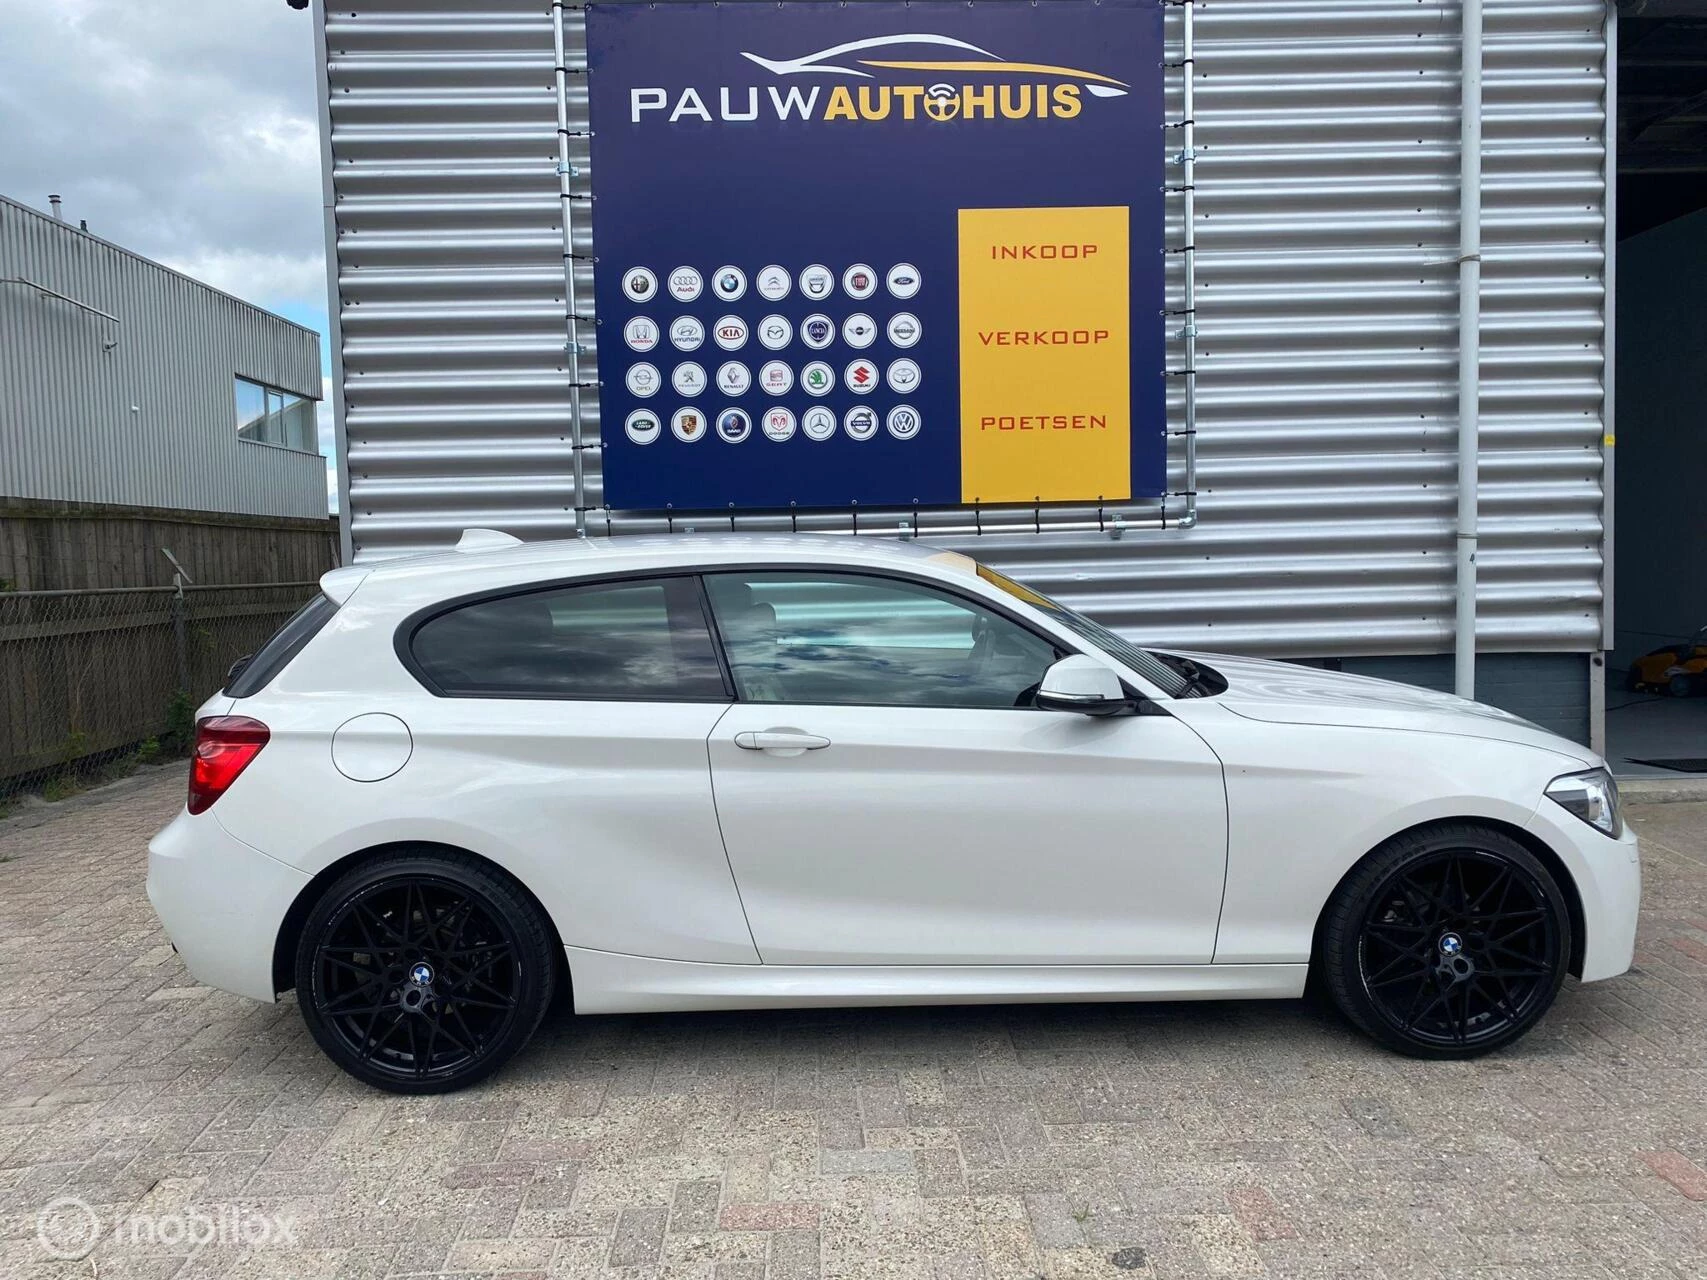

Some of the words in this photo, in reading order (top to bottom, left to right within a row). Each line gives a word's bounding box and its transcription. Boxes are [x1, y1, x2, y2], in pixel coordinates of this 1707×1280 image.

[992, 245, 1098, 260] INKOOP
[979, 331, 1109, 346] VERKOOP
[981, 415, 1107, 431] POETSEN
